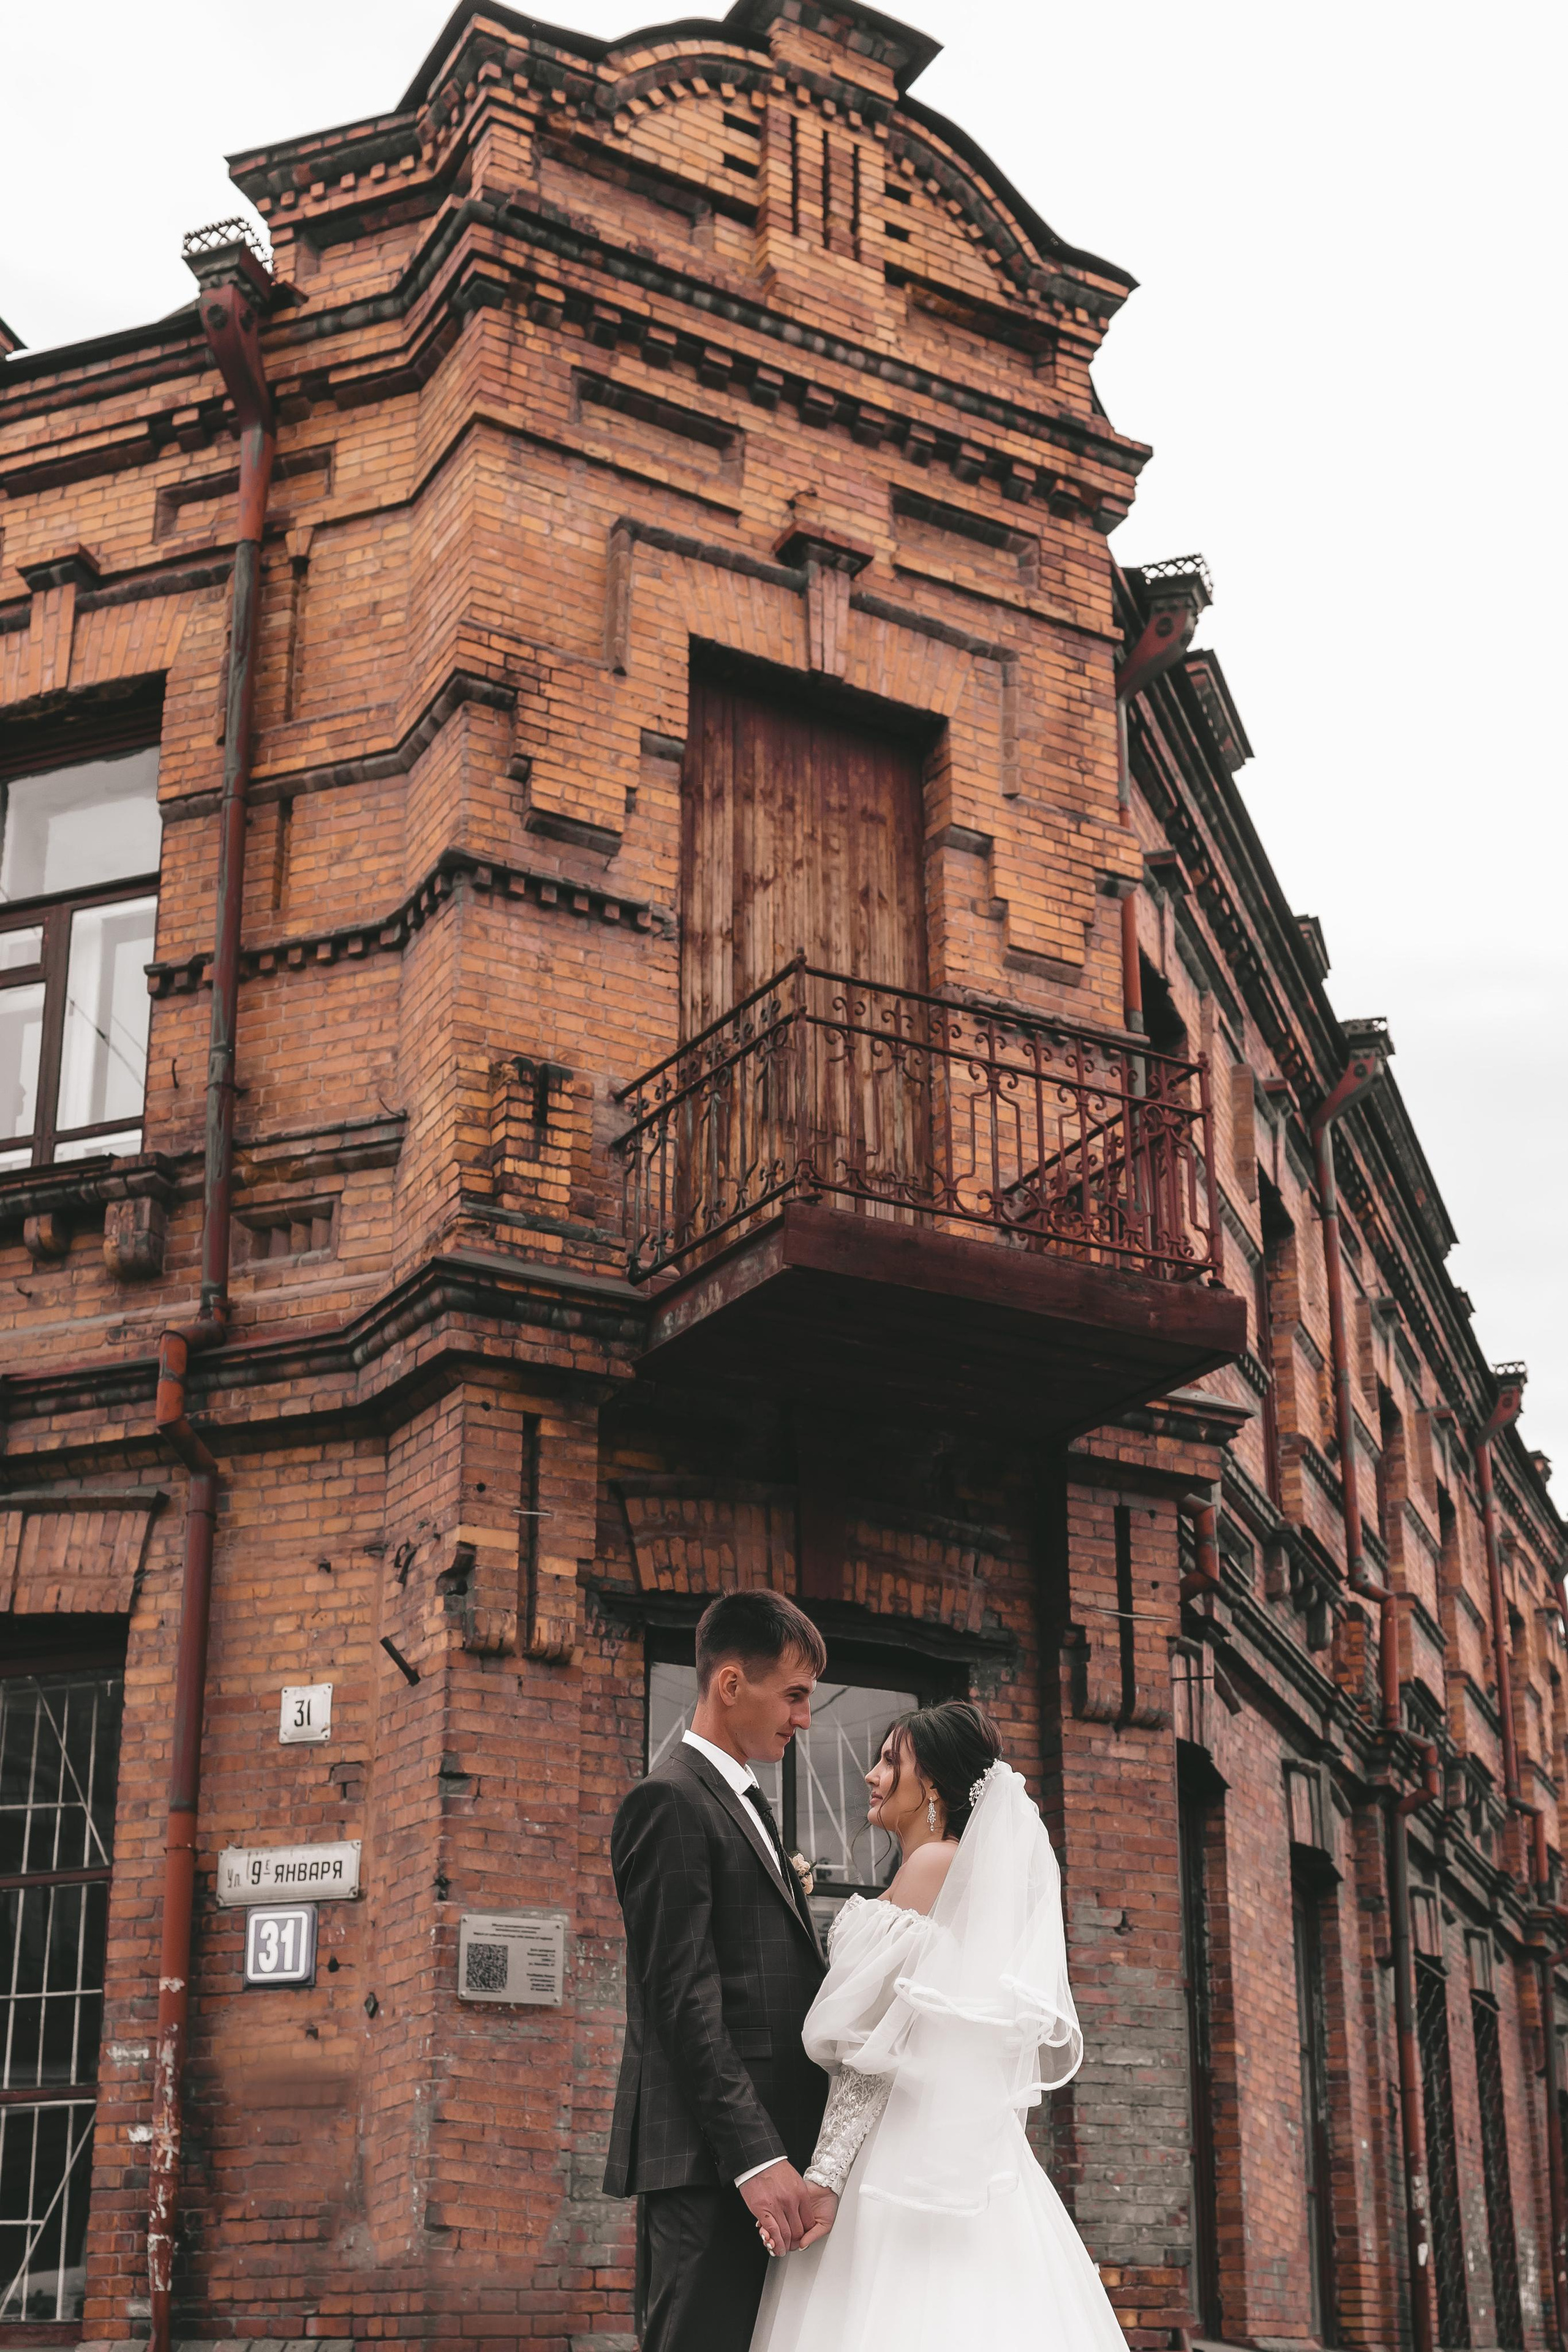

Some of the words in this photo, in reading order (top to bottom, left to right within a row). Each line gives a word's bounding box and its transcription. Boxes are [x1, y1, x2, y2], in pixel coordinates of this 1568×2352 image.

[294, 1698, 311, 1727] 31
[274, 1860, 343, 1883] ЯНВАРЯ
[258, 1918, 295, 1973] 31
